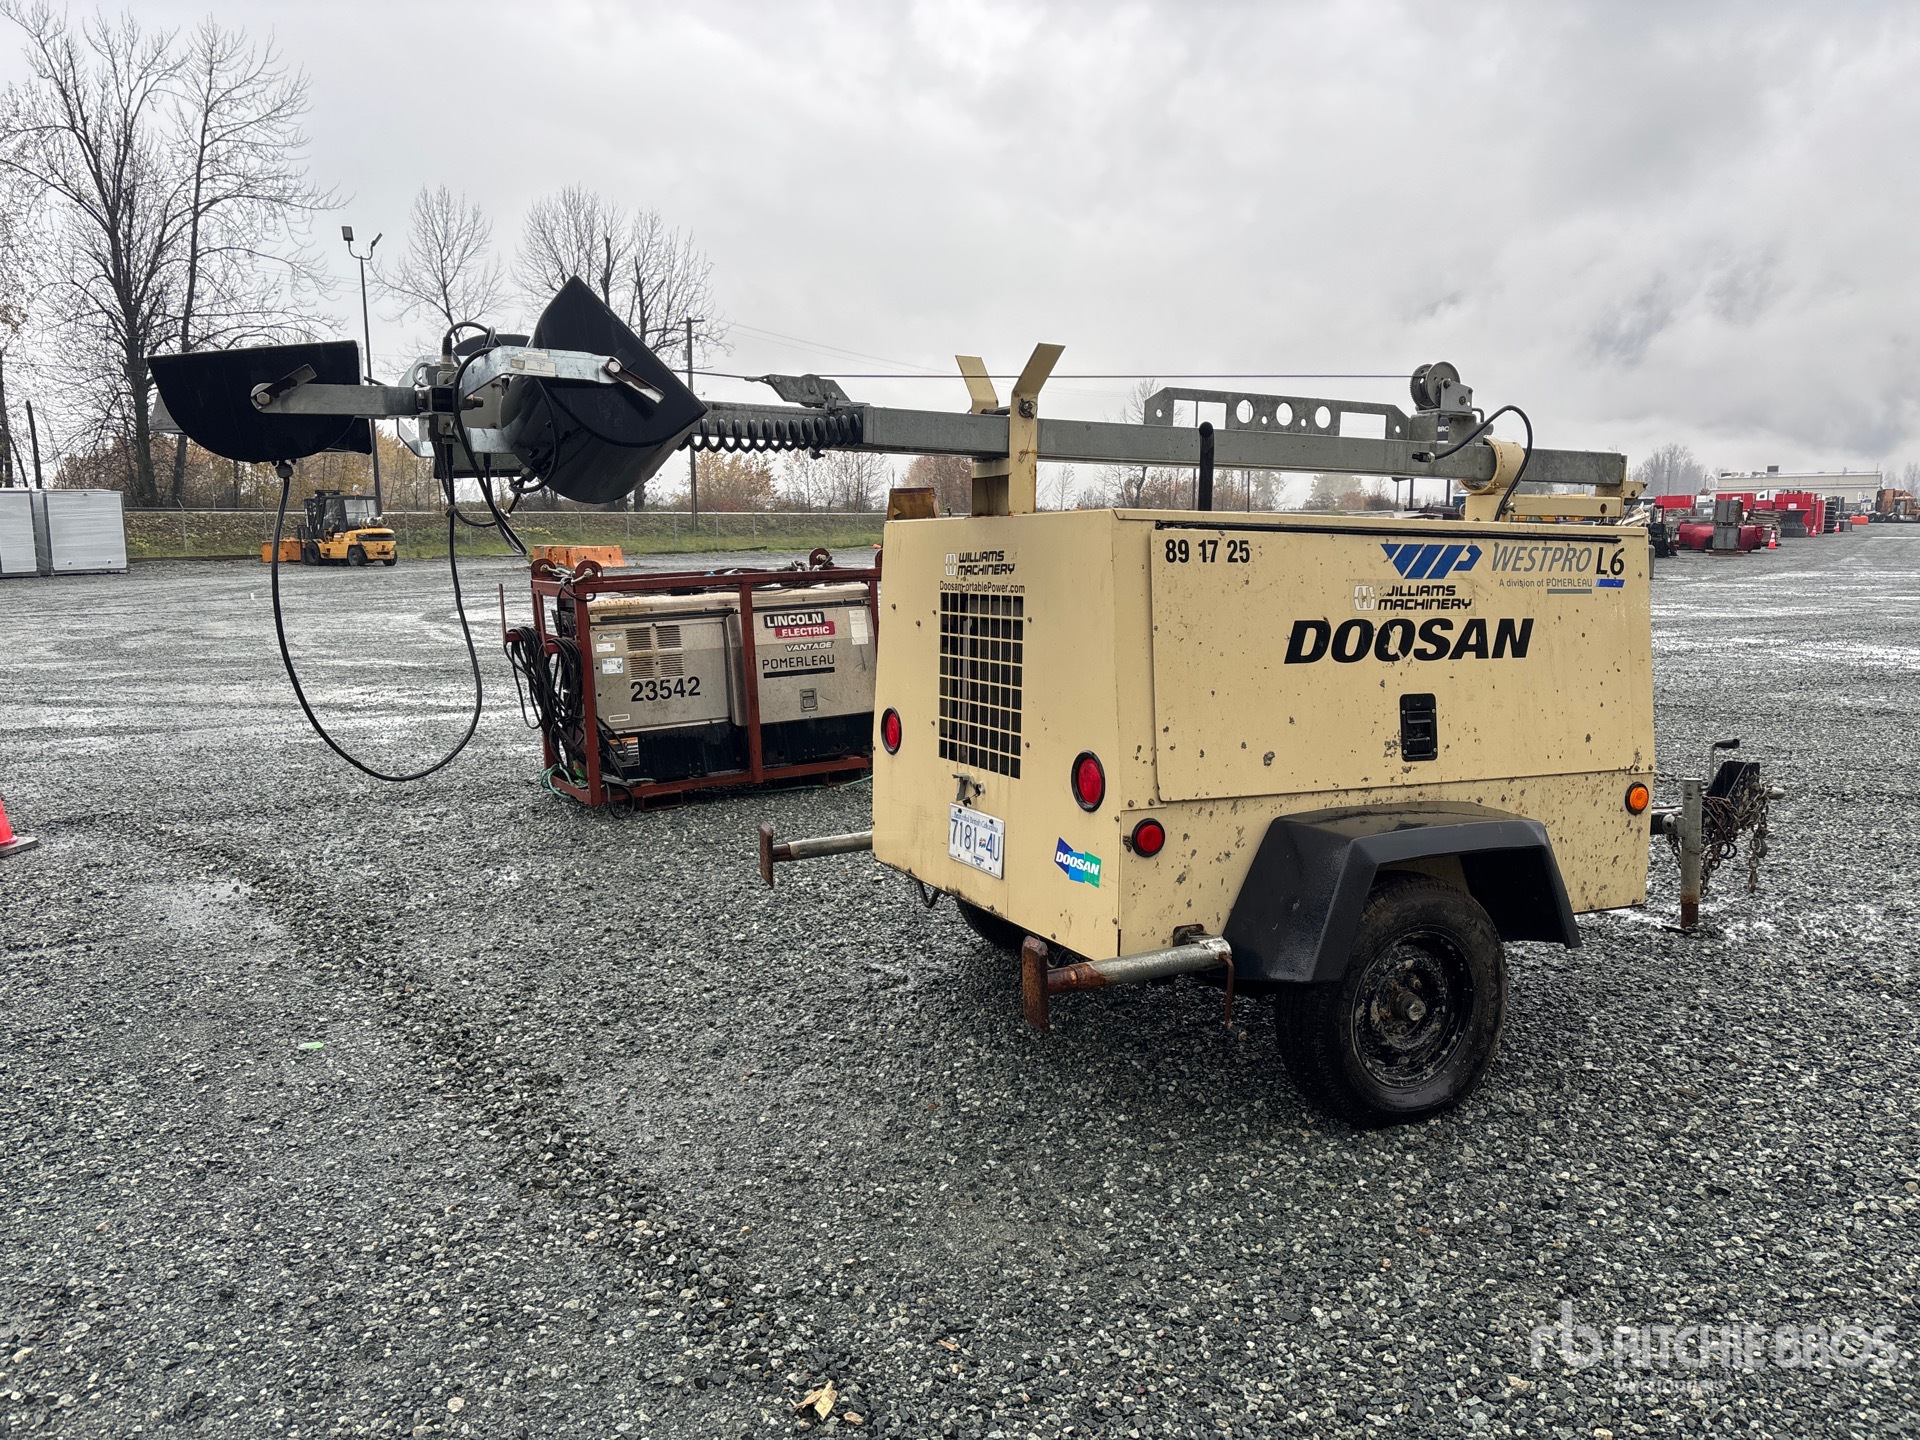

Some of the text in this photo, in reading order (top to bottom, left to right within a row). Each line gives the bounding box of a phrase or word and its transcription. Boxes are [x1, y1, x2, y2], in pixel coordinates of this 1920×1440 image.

[958, 550, 1005, 563] WILLIAMS
[1165, 539, 1250, 563] 89 17 25
[1491, 546, 1592, 573] WESTPRO
[1595, 547, 1625, 576] L6
[957, 563, 1015, 576] MACHINERY
[1499, 578, 1593, 588] A division of POMERLEAU
[1377, 598, 1472, 610] MACHINERY
[766, 613, 822, 627] LINCOLN
[781, 625, 830, 637] ELECTRIC
[785, 641, 833, 652] VANTAGE
[1283, 617, 1535, 664] DOOSAN
[762, 654, 835, 670] POMERLEAU
[630, 677, 700, 702] 23542
[951, 818, 977, 853] 7181
[1055, 851, 1100, 876] DOOSAN
